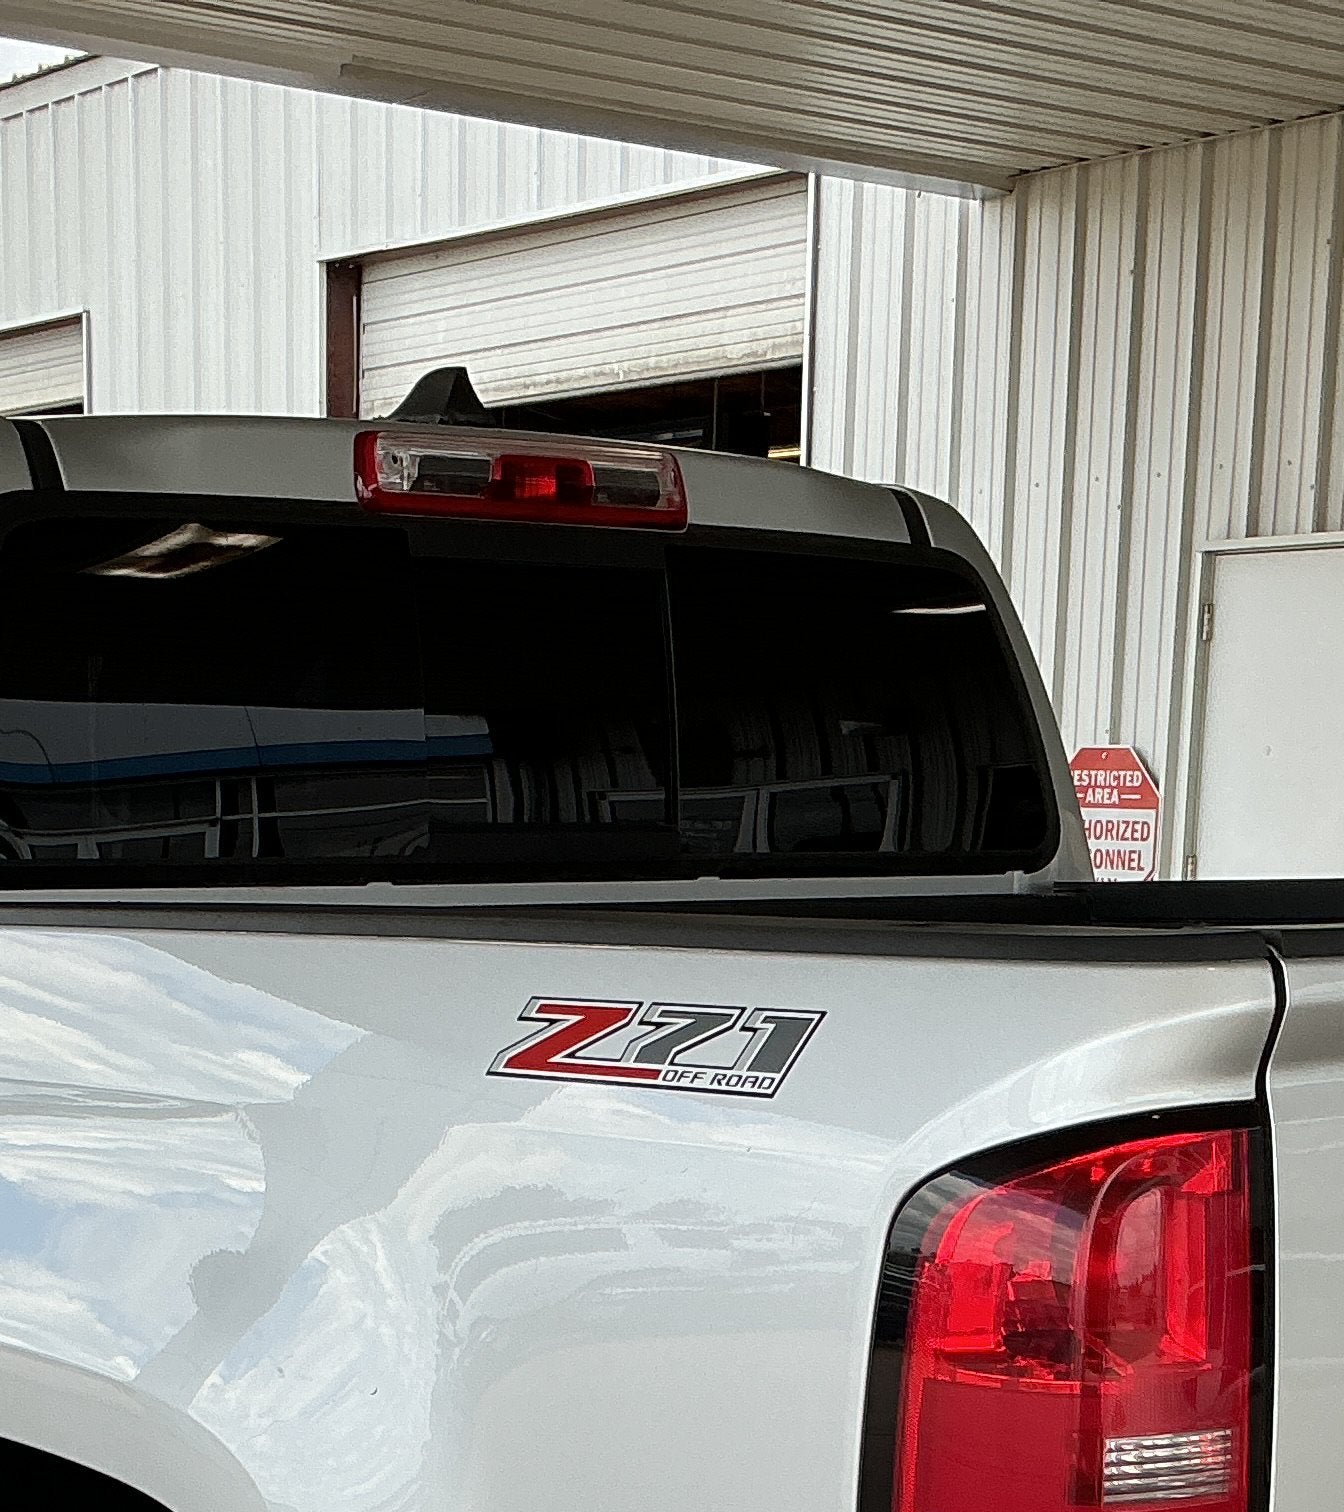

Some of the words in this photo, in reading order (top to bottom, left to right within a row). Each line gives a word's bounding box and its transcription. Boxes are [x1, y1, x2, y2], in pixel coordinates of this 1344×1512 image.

[1071, 769, 1143, 787] ESTRICTED
[1085, 787, 1120, 804] AREA
[1084, 820, 1151, 842] HORIZED
[1090, 848, 1145, 871] ONNEL
[486, 996, 828, 1098] Z71
[661, 1069, 707, 1084] OFF
[709, 1073, 776, 1090] ROAD
